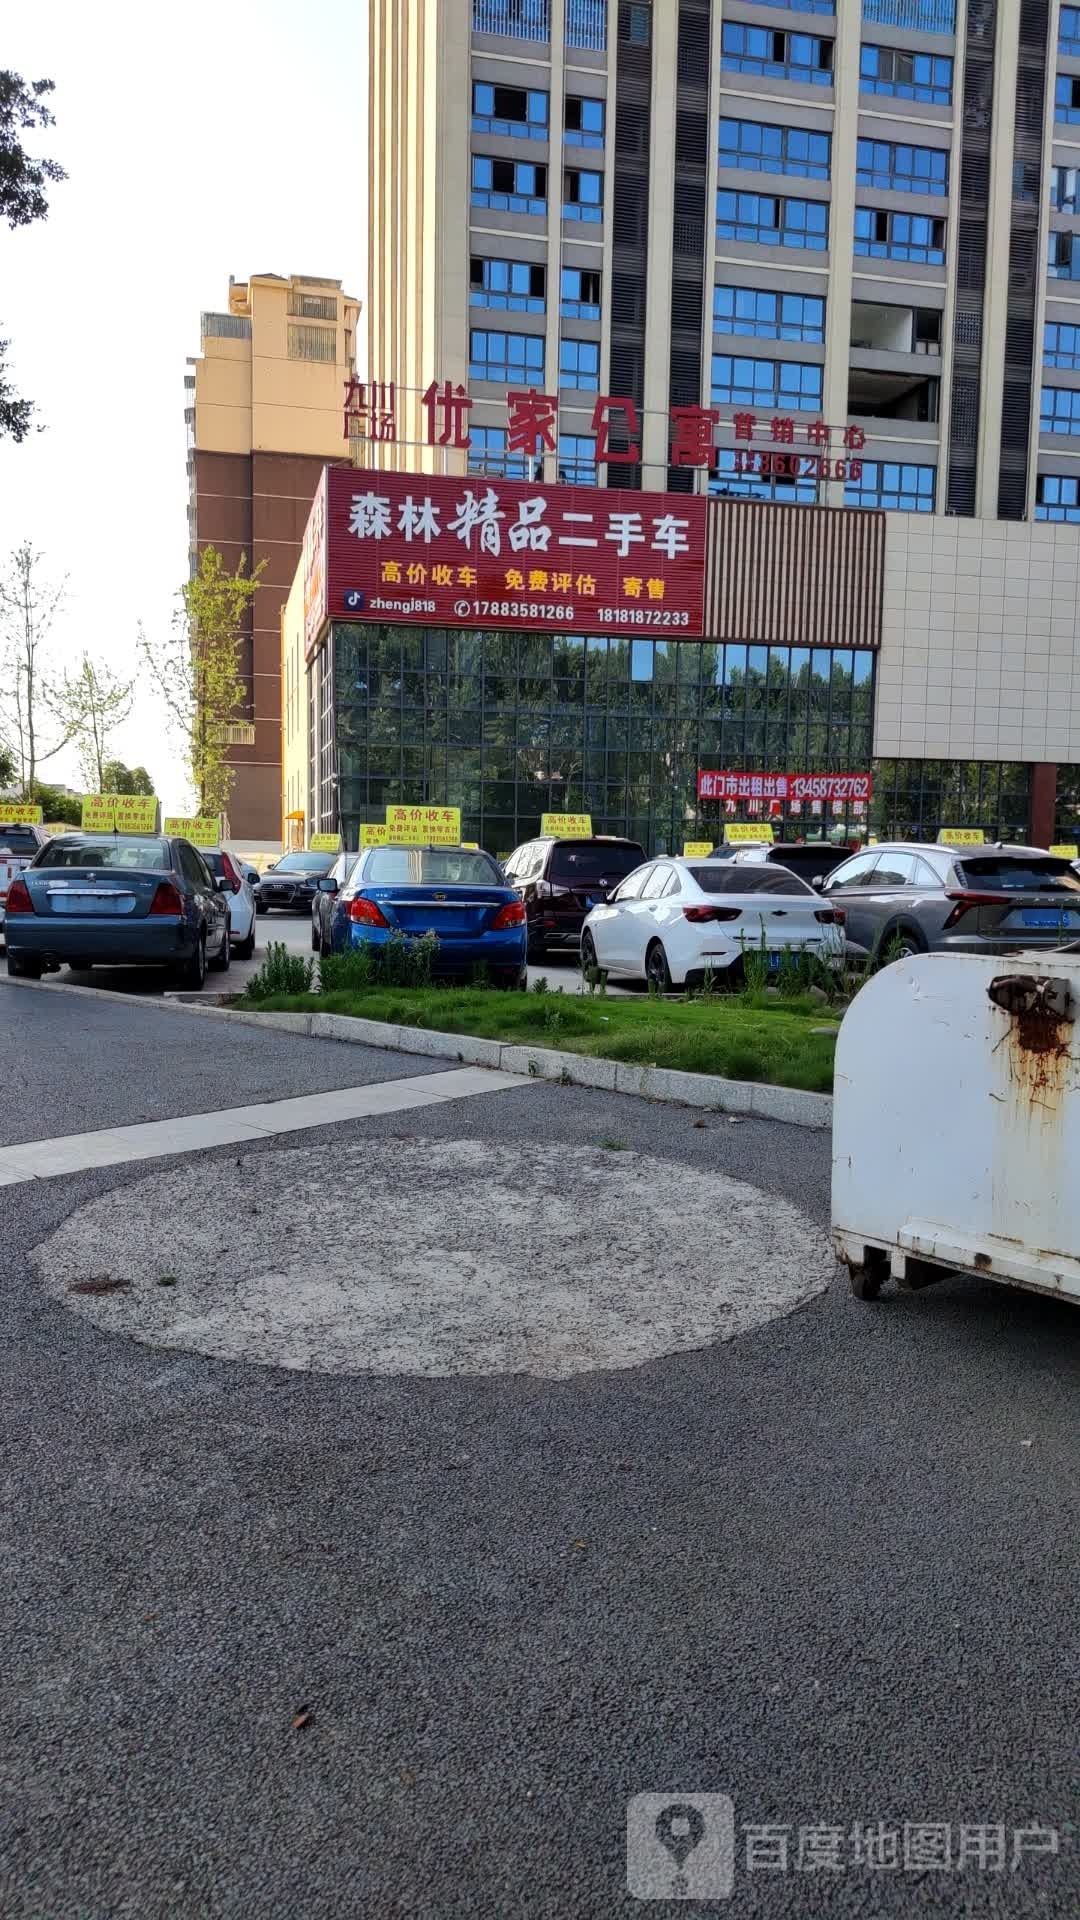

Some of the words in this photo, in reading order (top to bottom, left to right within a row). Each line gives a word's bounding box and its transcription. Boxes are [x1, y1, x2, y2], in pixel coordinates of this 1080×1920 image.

[344, 378, 394, 411] 九川
[344, 408, 396, 442] 广场
[422, 380, 719, 469] 优家公寓
[733, 412, 866, 449] 营销中心
[348, 488, 690, 560] 森林精品二手车
[381, 561, 478, 588] 高价收车
[504, 568, 597, 596] 免费评估
[623, 576, 665, 600] 寄售
[473, 602, 574, 621] 17883581266
[597, 608, 689, 626] 18181872233
[0, 806, 37, 816] 价收车
[91, 796, 150, 808] 高价收车
[394, 808, 455, 822] 高价收车
[170, 819, 214, 830] 高价收车
